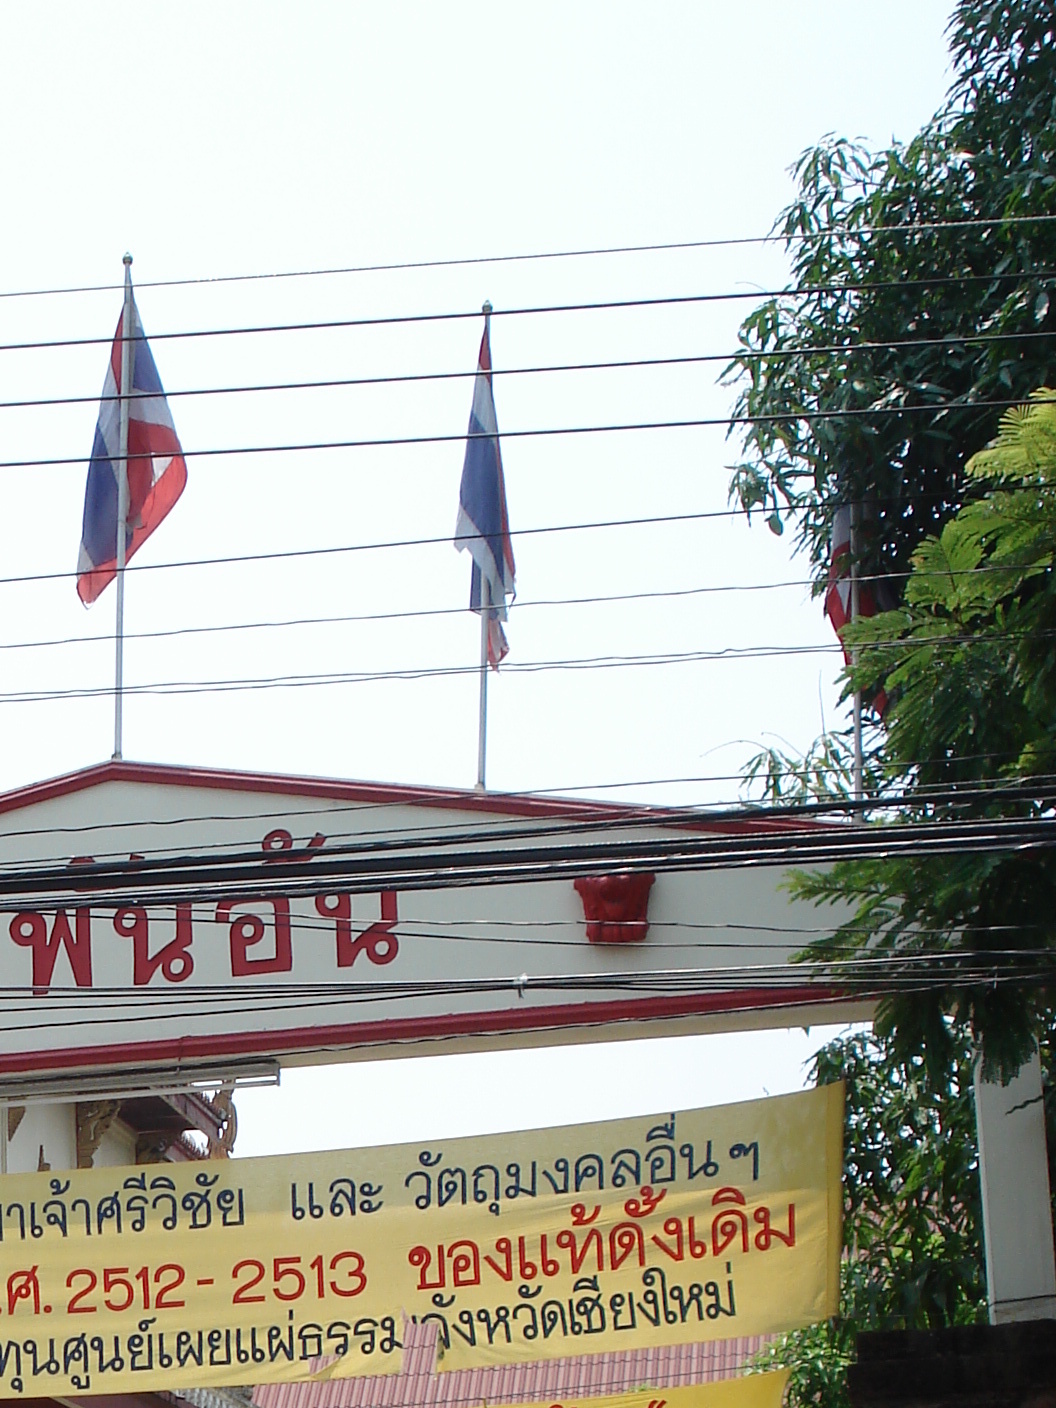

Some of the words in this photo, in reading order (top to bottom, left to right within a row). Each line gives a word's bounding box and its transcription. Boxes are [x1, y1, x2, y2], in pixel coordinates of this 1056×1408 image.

[292, 1179, 383, 1220] และ
[409, 1187, 794, 1290] ของแท้ดั้งเดิม
